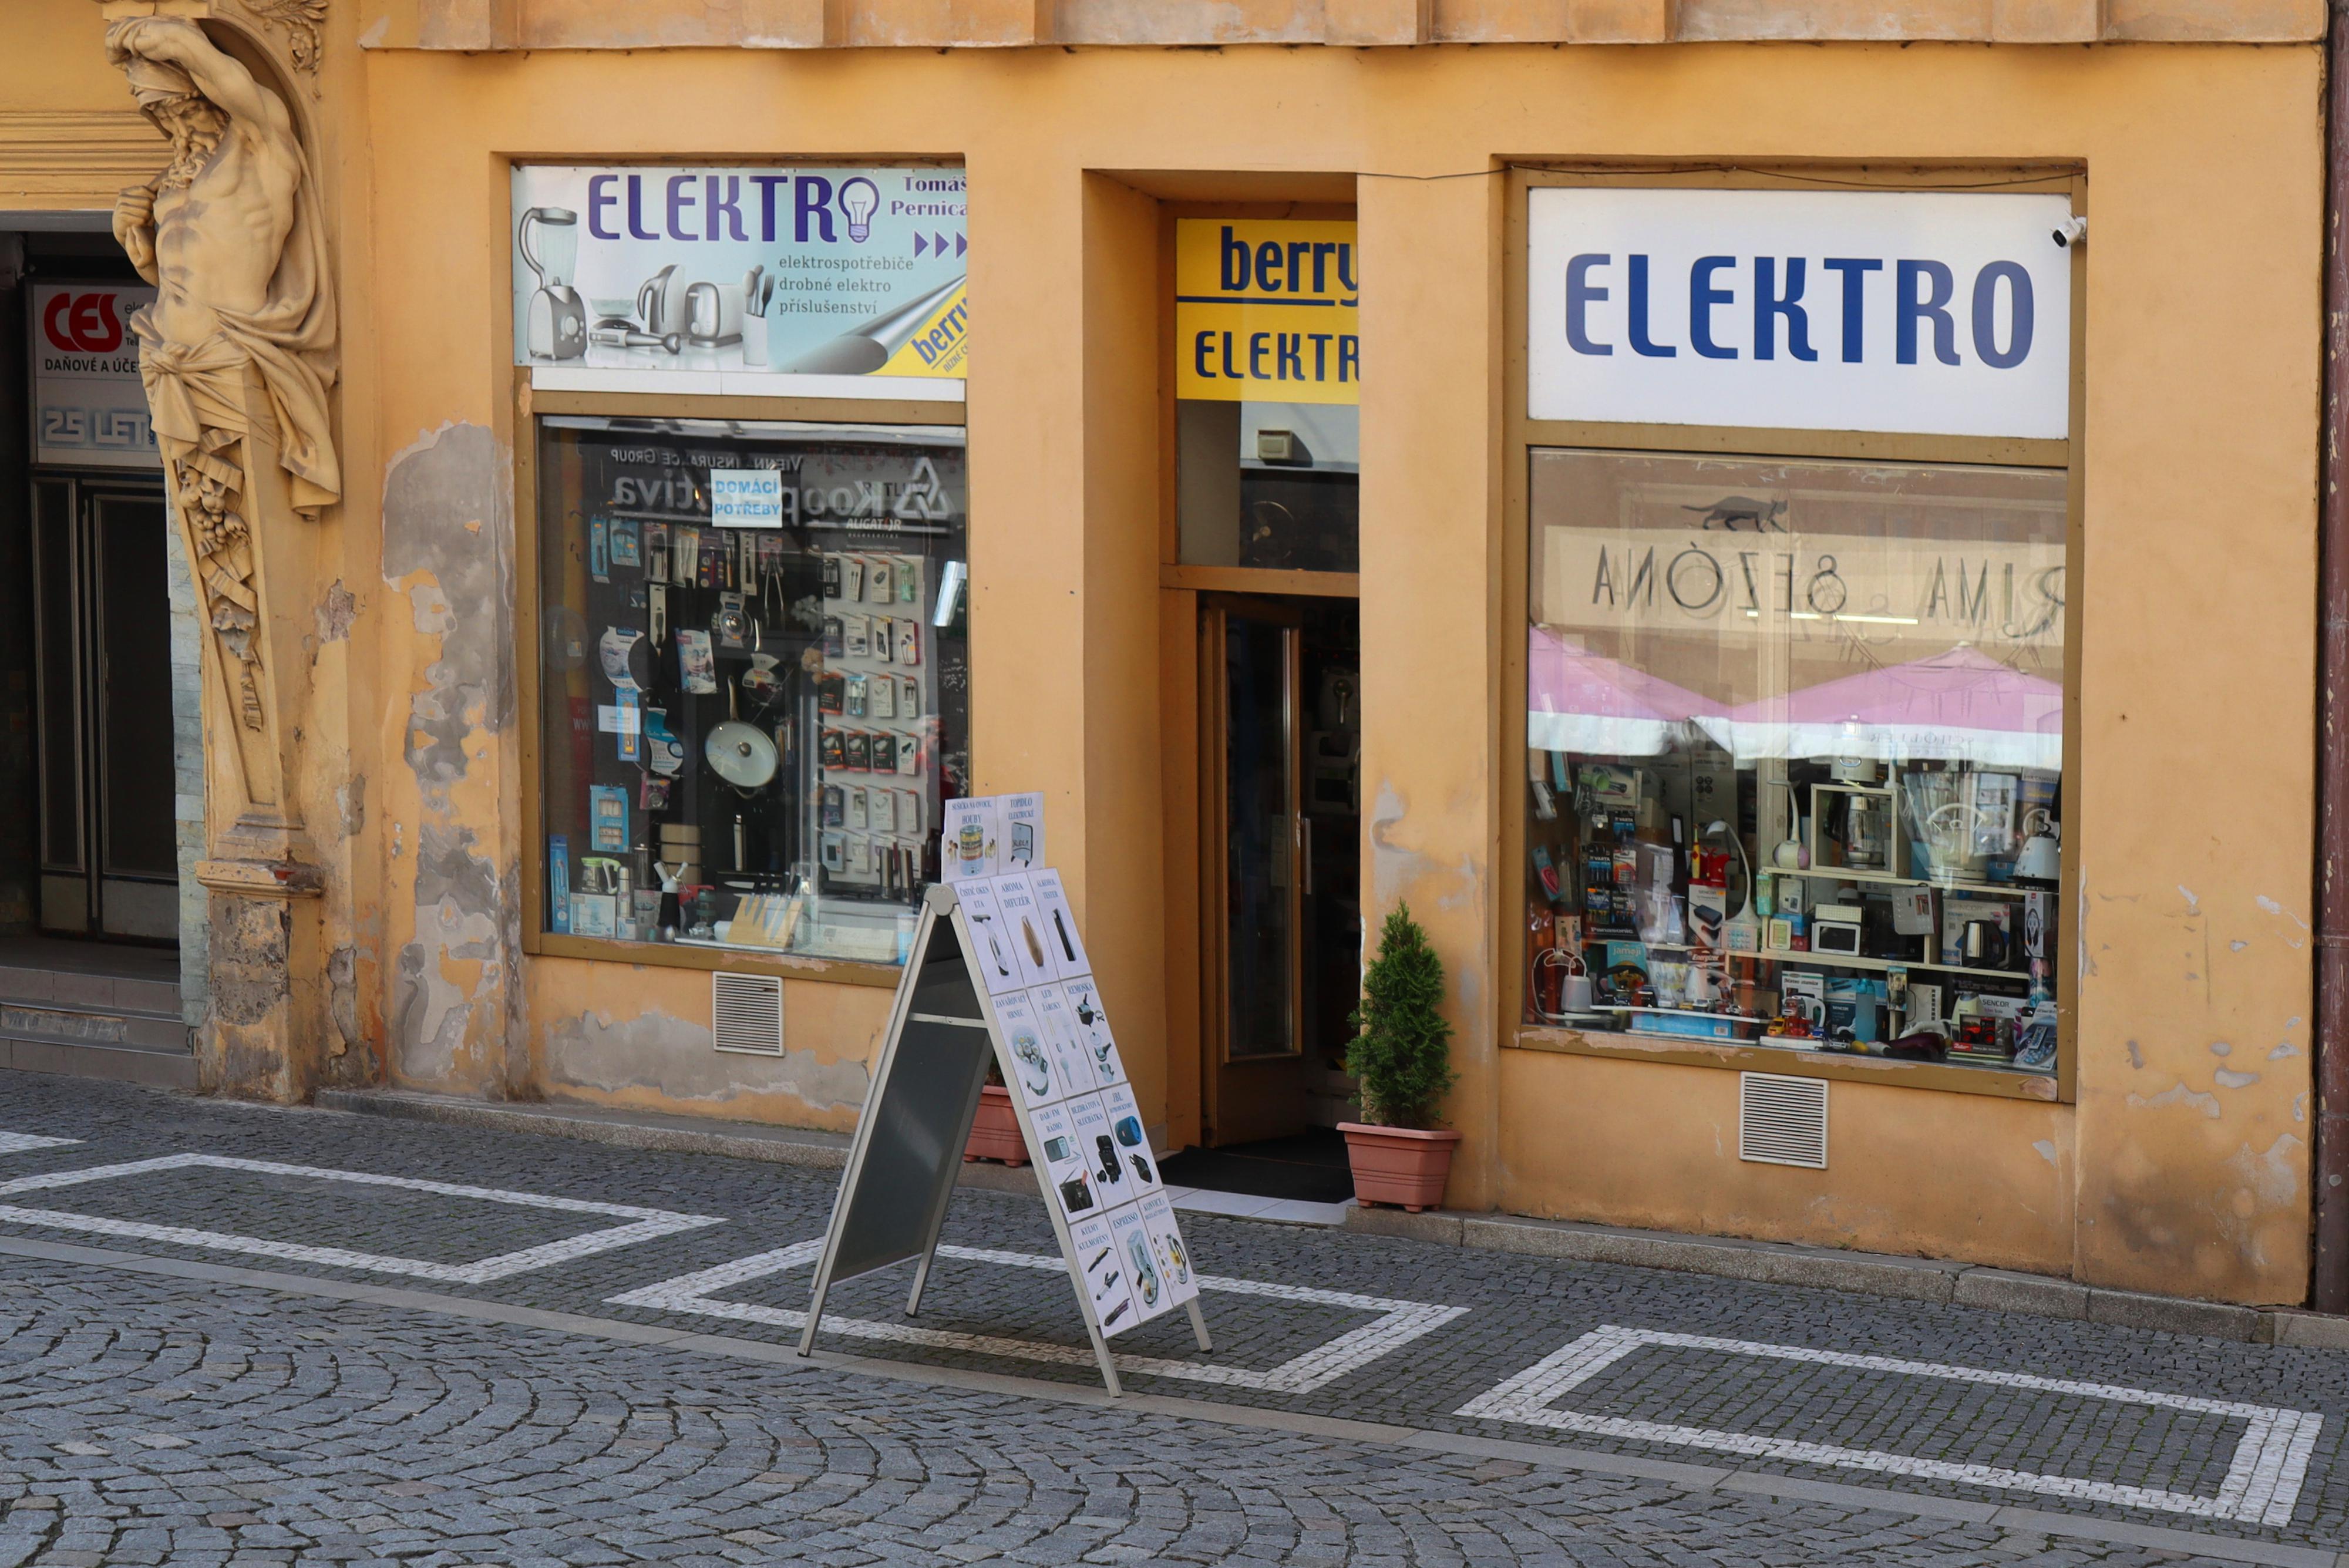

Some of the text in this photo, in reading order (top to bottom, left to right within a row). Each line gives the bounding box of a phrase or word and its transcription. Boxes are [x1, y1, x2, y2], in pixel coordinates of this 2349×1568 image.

[891, 200, 967, 216] Pernica
[779, 255, 914, 272] elektrospotřebiče
[780, 277, 891, 292] drobné elektro
[780, 298, 877, 315] příslušenství
[1566, 253, 2034, 369] ELEKTRO
[44, 292, 122, 352] CES
[45, 356, 96, 372] DAŇOVÉ
[100, 362, 109, 372] A
[46, 410, 85, 442] 25
[95, 411, 149, 444] LET
[715, 479, 778, 494] DOMÁCÍ
[715, 502, 780, 516] POTŘEBY
[1011, 798, 1032, 808] TOPIDLO
[962, 814, 981, 825] HOUBY
[1008, 810, 1034, 820] ELEKTRICKÉ
[1001, 882, 1024, 893] AROMA
[974, 900, 985, 909] ETA
[1004, 894, 1031, 909] DIFUZÉR
[1692, 954, 1719, 962] Energizer
[1041, 989, 1052, 998] LED
[1983, 999, 2010, 1008] SENCOR
[1112, 1092, 1123, 1103] JBL
[1077, 1112, 1104, 1126] SLUCHÁTKA
[1046, 1122, 1062, 1133] RÁDIO
[1113, 1212, 1138, 1229] ESPRESSO
[1081, 1223, 1099, 1236] KULMY
